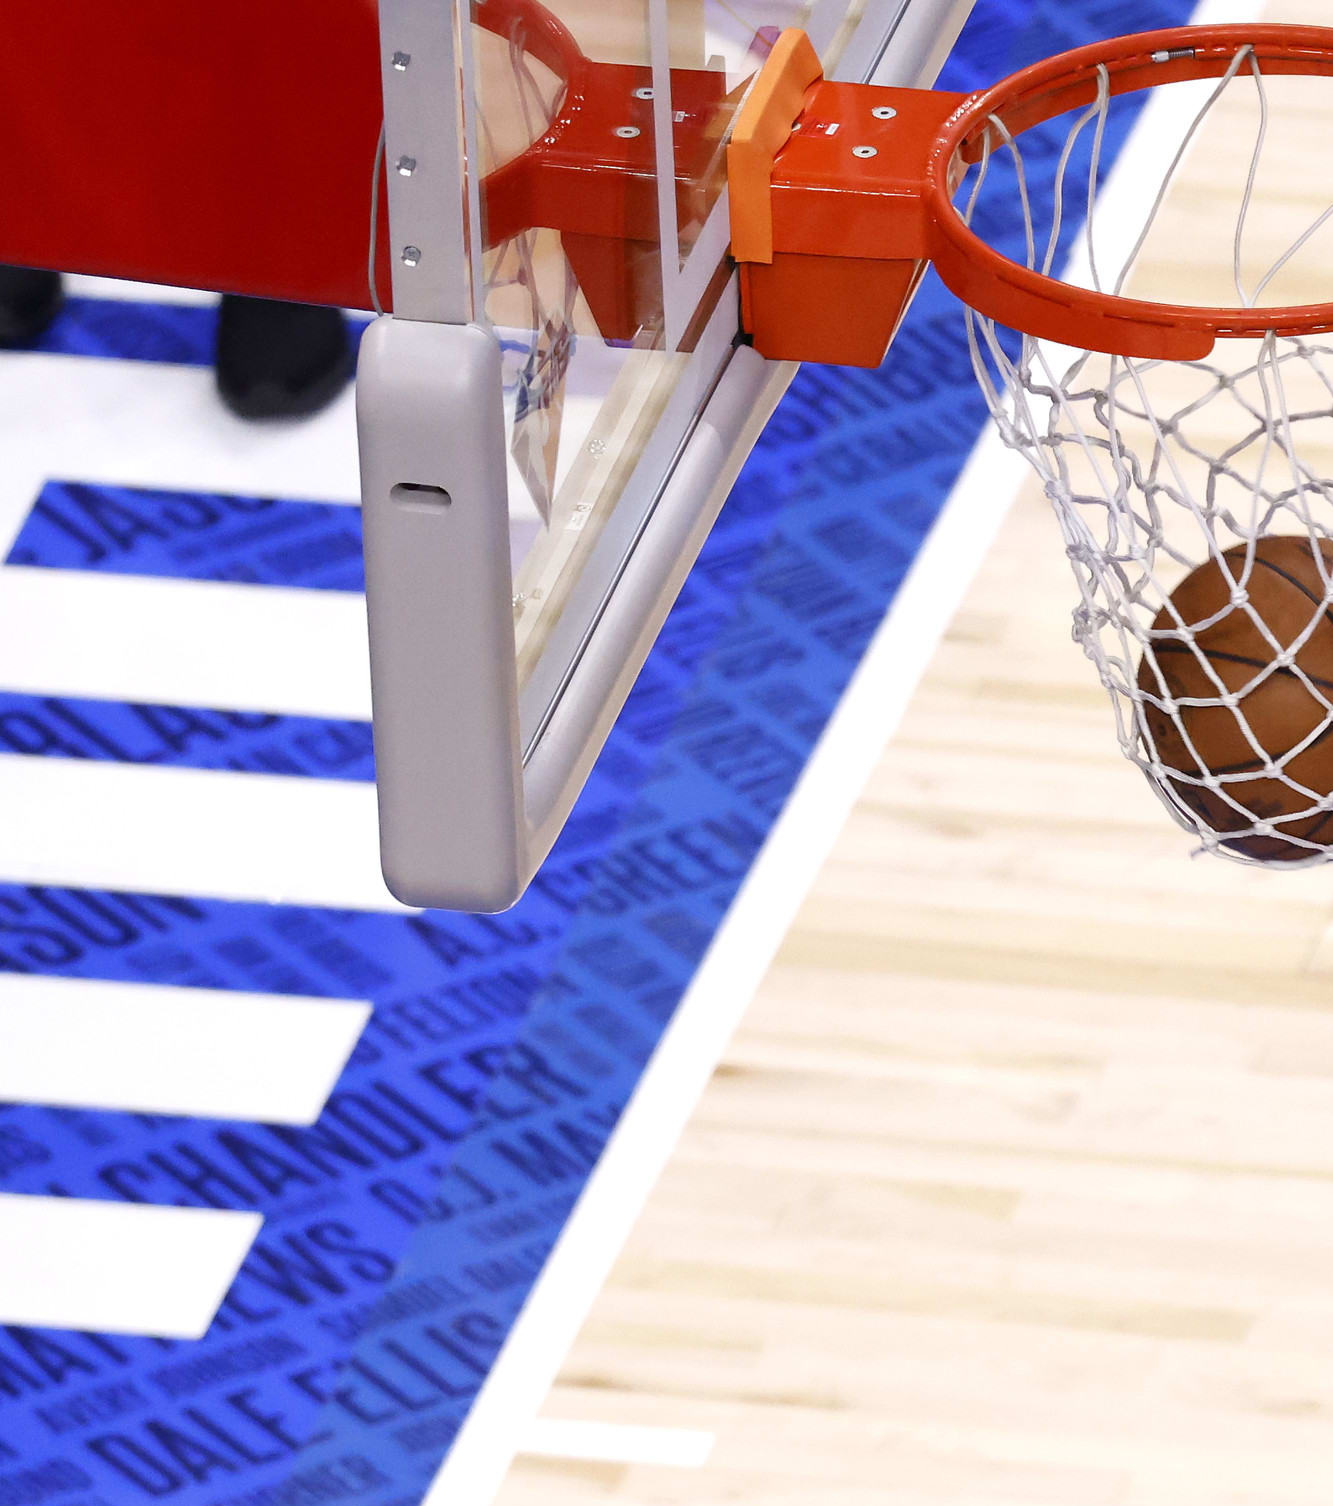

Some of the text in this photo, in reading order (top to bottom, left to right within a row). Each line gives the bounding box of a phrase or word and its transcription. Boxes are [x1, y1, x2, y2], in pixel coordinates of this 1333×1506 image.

[96, 1039, 591, 1210] CHANDLER
[85, 1386, 335, 1498] DALE
[288, 1311, 503, 1426] ELLIS
